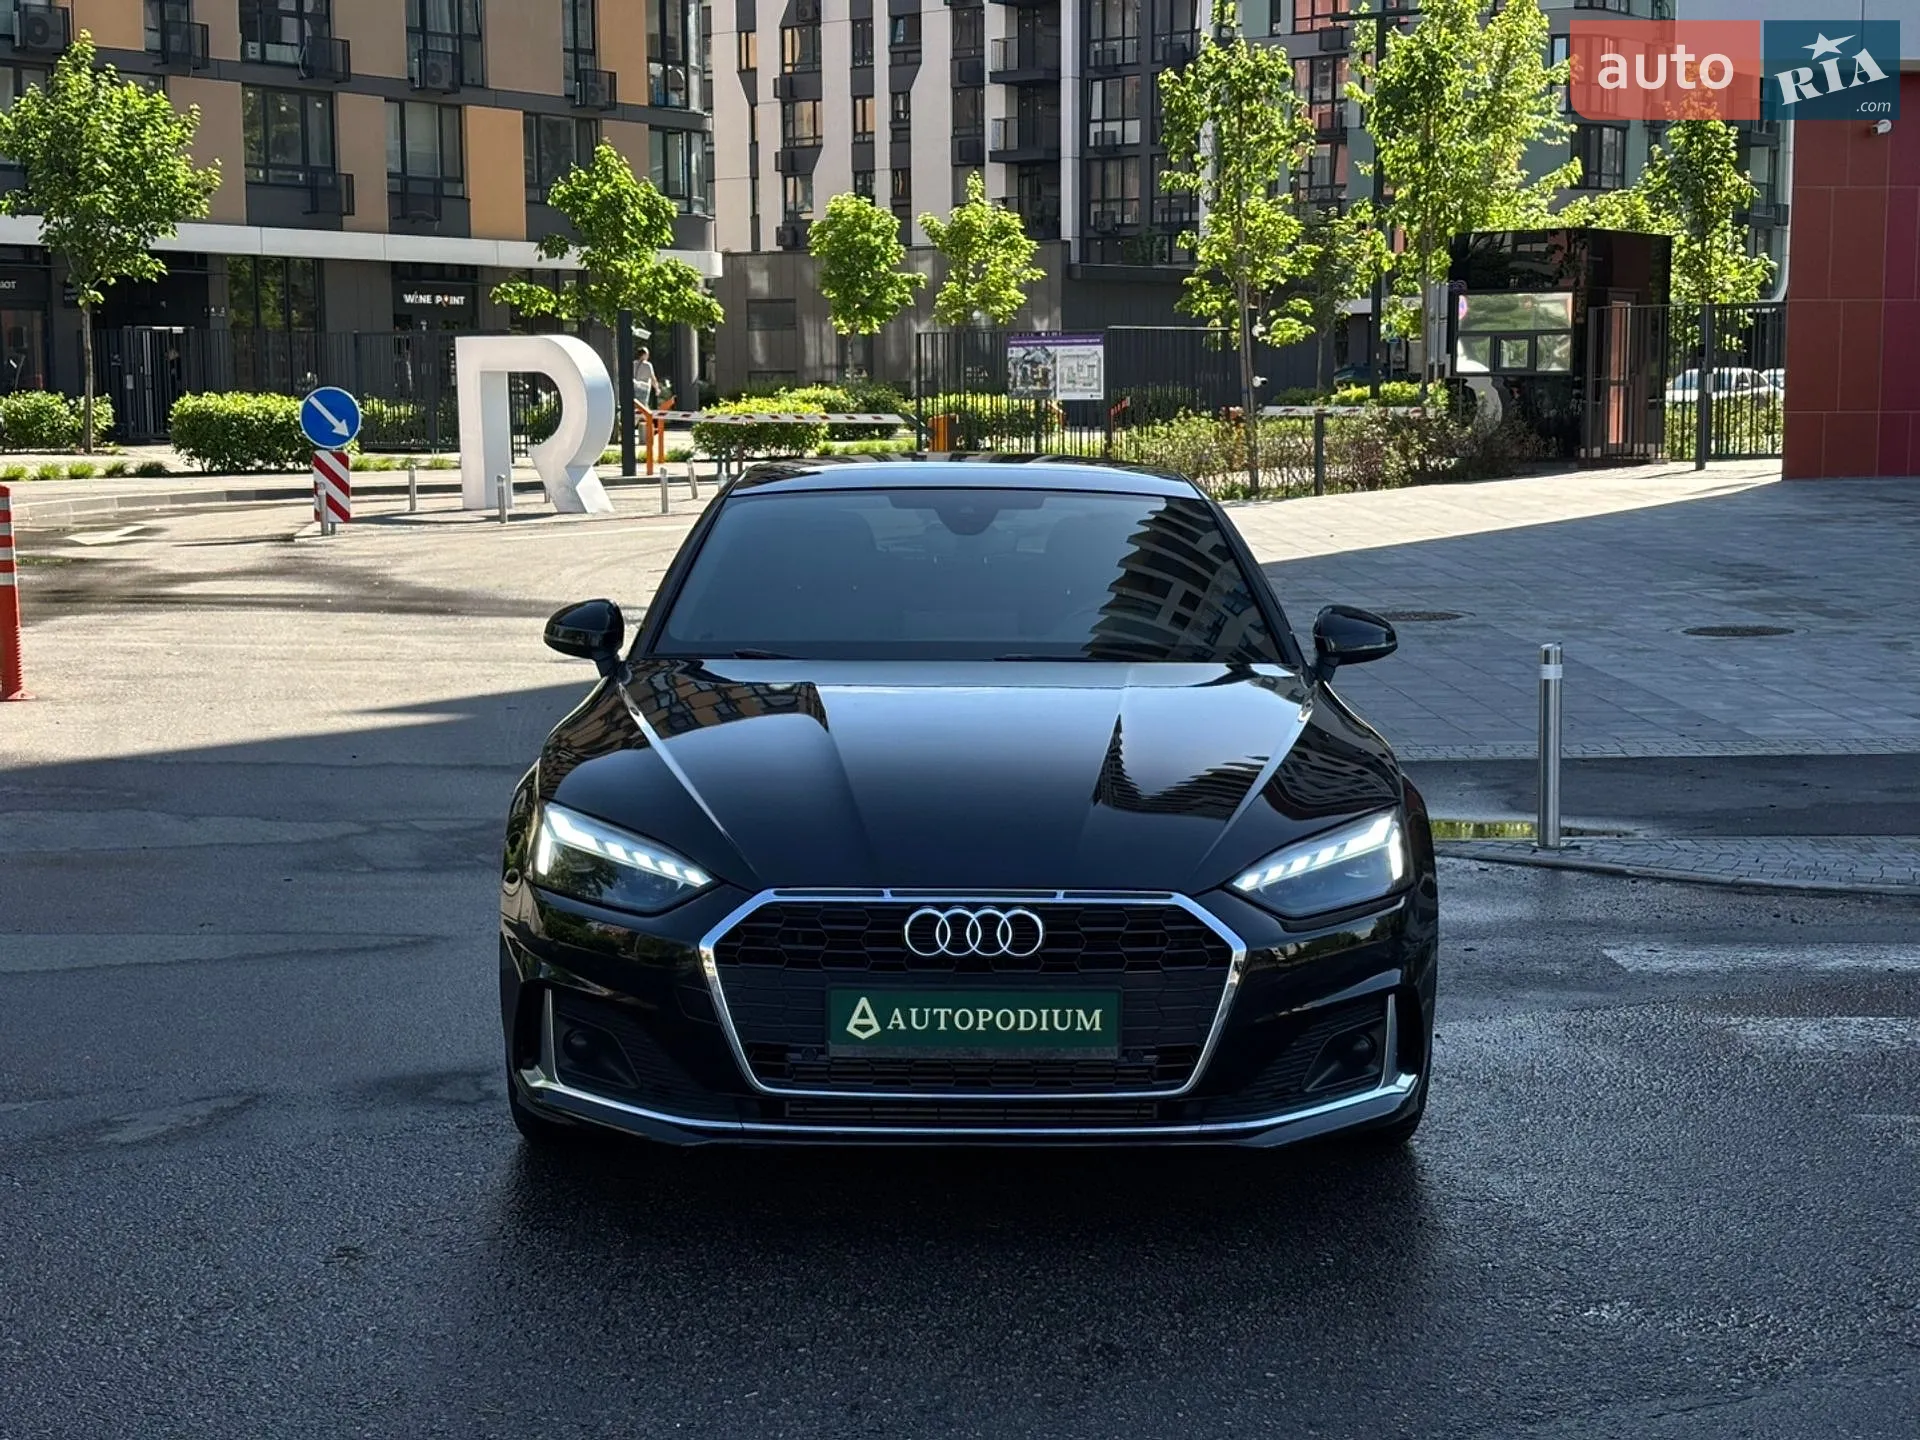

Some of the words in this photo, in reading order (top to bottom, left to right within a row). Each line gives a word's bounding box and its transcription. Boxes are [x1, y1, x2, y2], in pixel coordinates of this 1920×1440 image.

[403, 291, 433, 304] WINE
[434, 294, 466, 307] POINT
[455, 334, 616, 514] R
[886, 1007, 1103, 1032] AUTOPODIUM
